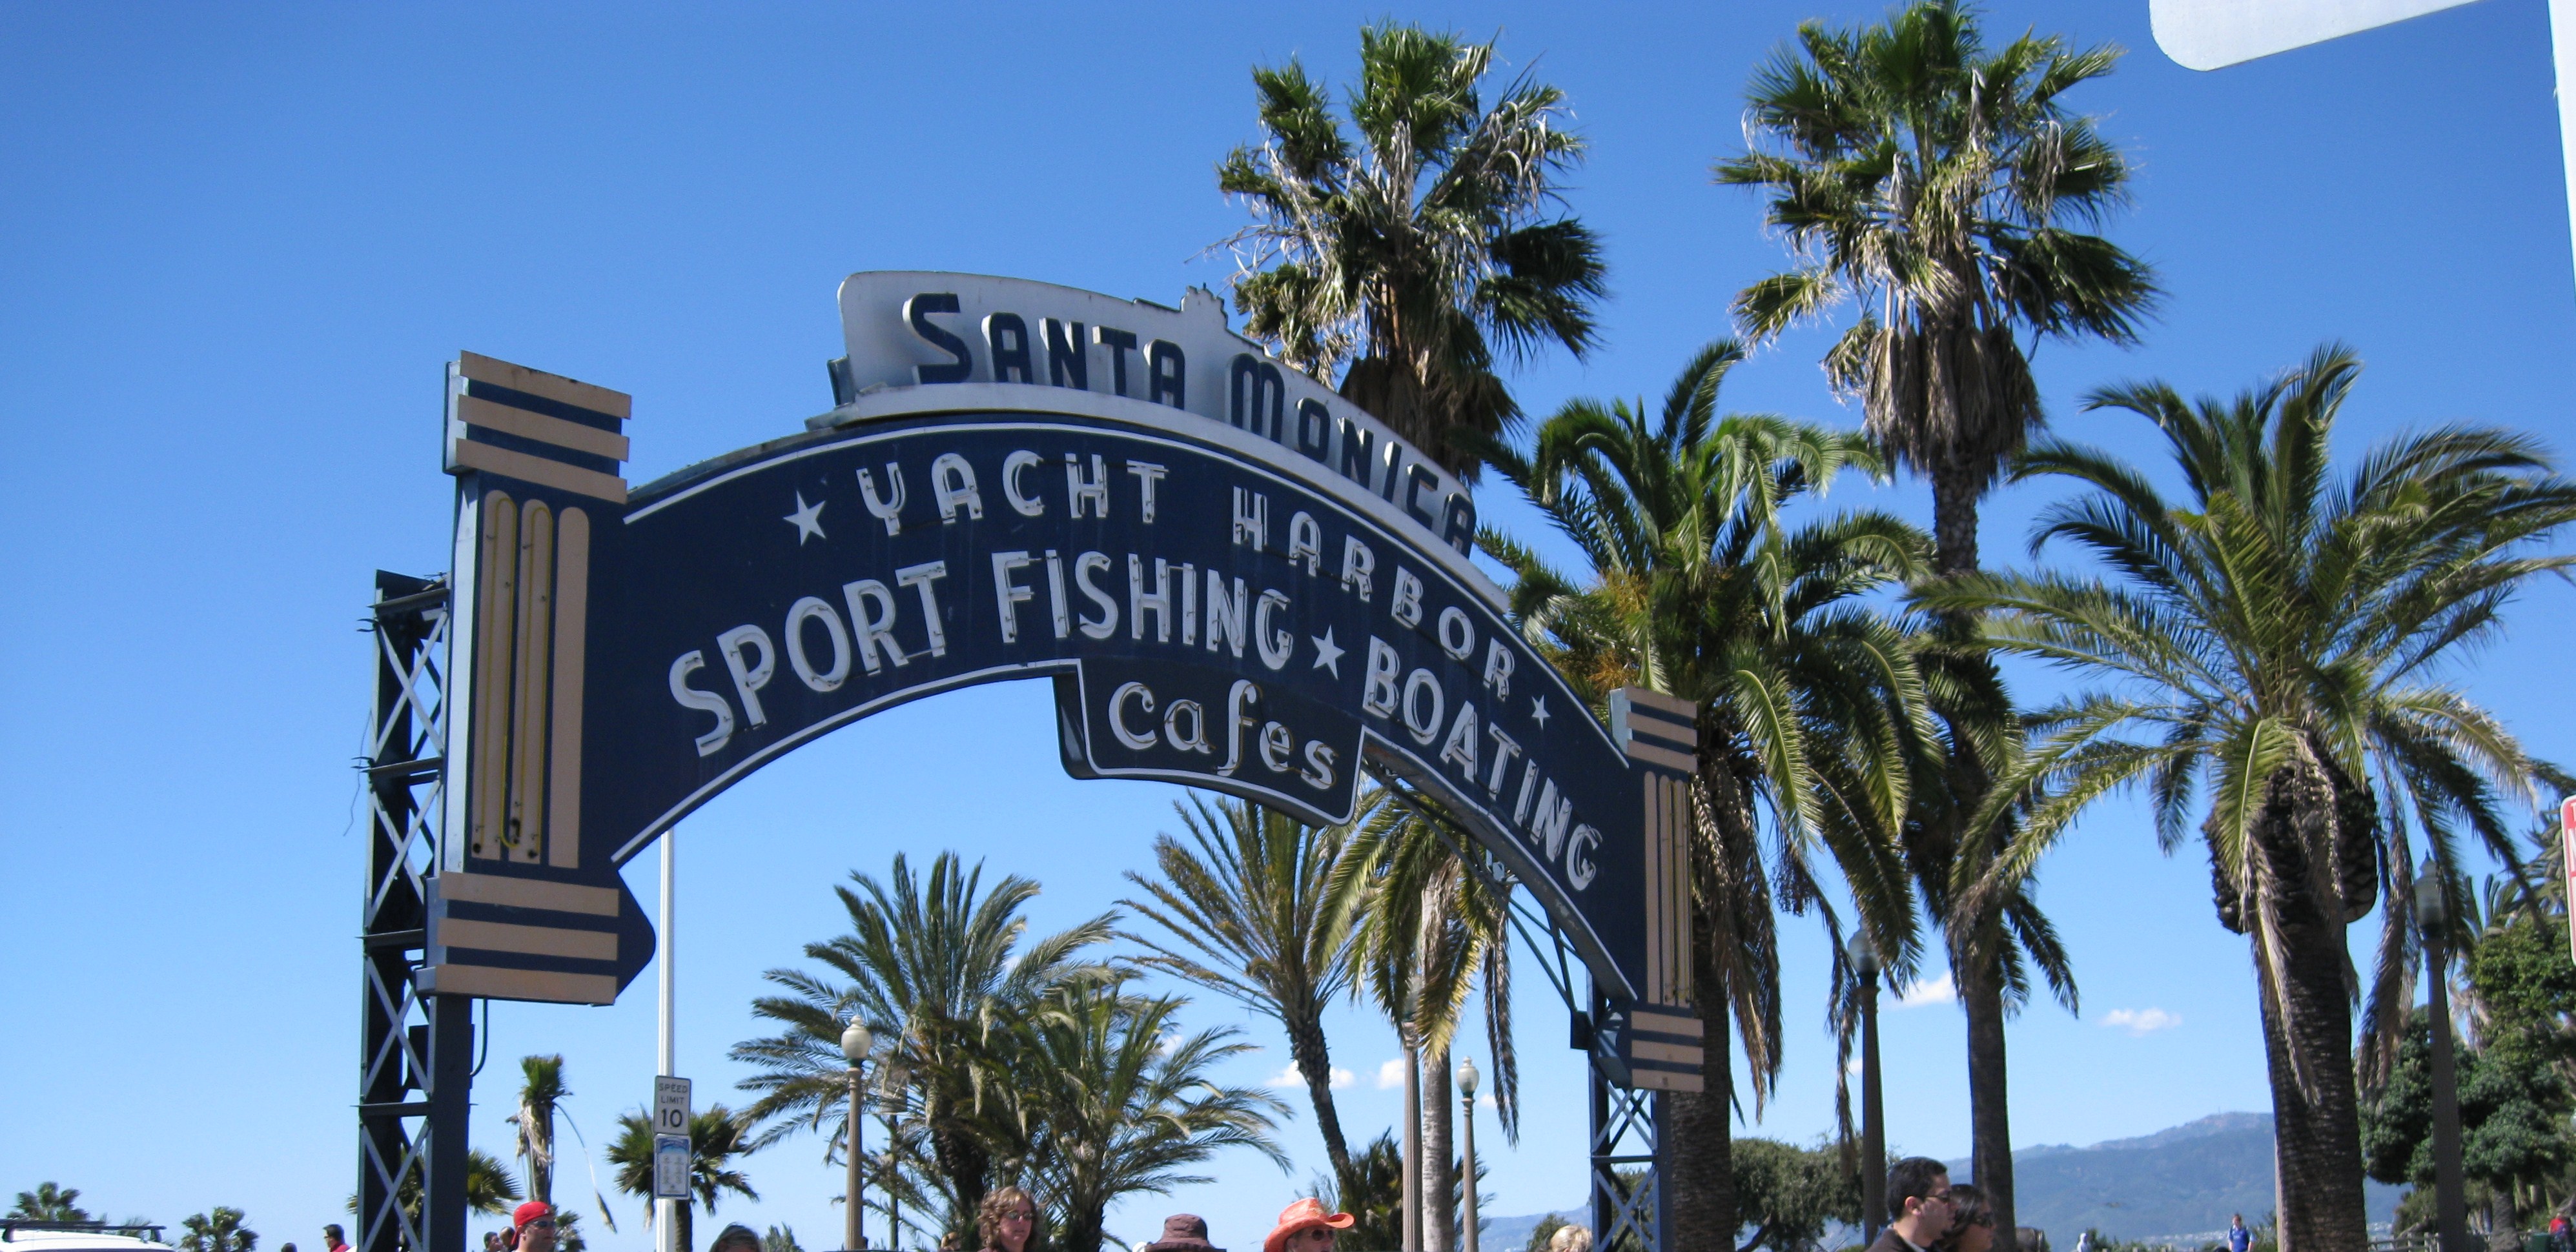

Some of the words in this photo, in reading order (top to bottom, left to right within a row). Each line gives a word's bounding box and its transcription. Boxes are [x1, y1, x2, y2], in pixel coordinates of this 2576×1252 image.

[903, 293, 1187, 409] SANTA
[1225, 352, 1476, 560] MONICA
[855, 449, 1169, 537] YACHT
[1232, 485, 1515, 702] HARBOR
[668, 560, 947, 758] SPORT
[991, 549, 1293, 671] FISHING
[1362, 634, 1602, 892] BOATING
[659, 1083, 688, 1093] SPEED
[660, 1096, 684, 1105] LIMIT
[661, 1108, 682, 1128] 10
